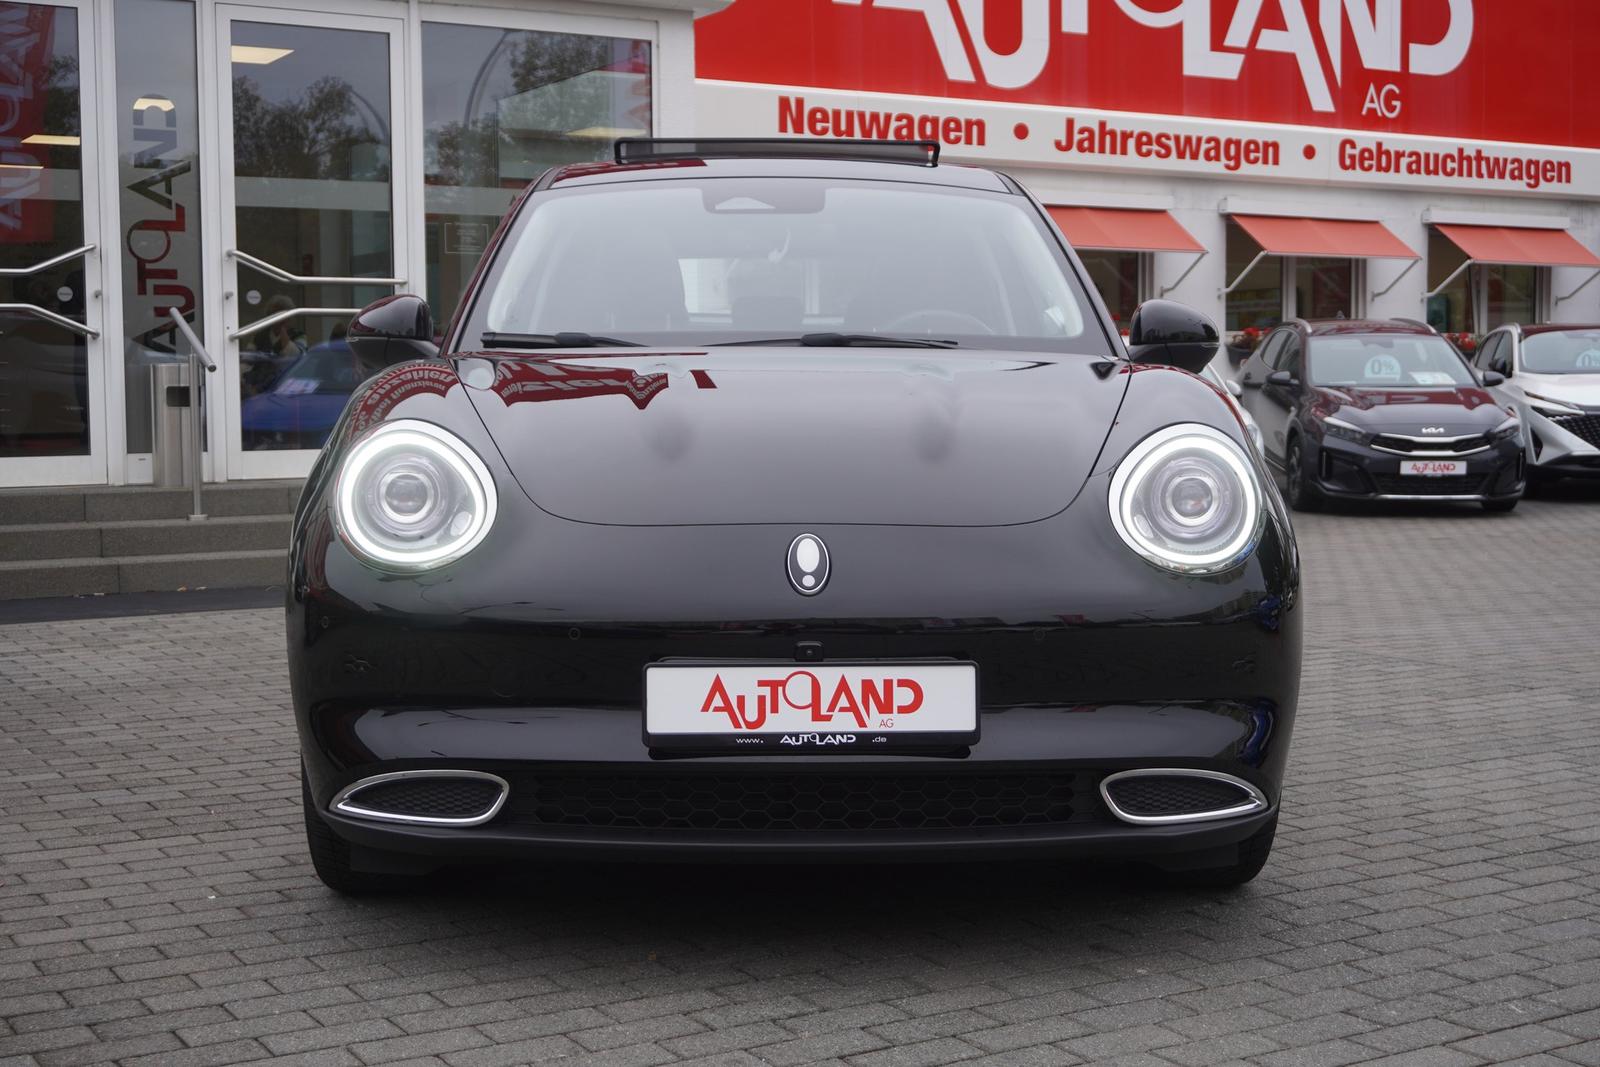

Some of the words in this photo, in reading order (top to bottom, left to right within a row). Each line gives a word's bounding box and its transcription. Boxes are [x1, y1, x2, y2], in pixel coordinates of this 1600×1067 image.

[1361, 82, 1401, 118] AG
[778, 95, 986, 152] Neuwagen
[1054, 117, 1280, 171] Jahreswagen
[1338, 138, 1572, 188] Gebrauchtwagen
[126, 94, 195, 354] AUTOLAND
[700, 670, 924, 730] AUTOLAND
[879, 718, 894, 728] AG
[780, 732, 856, 746] AUTOLAND
